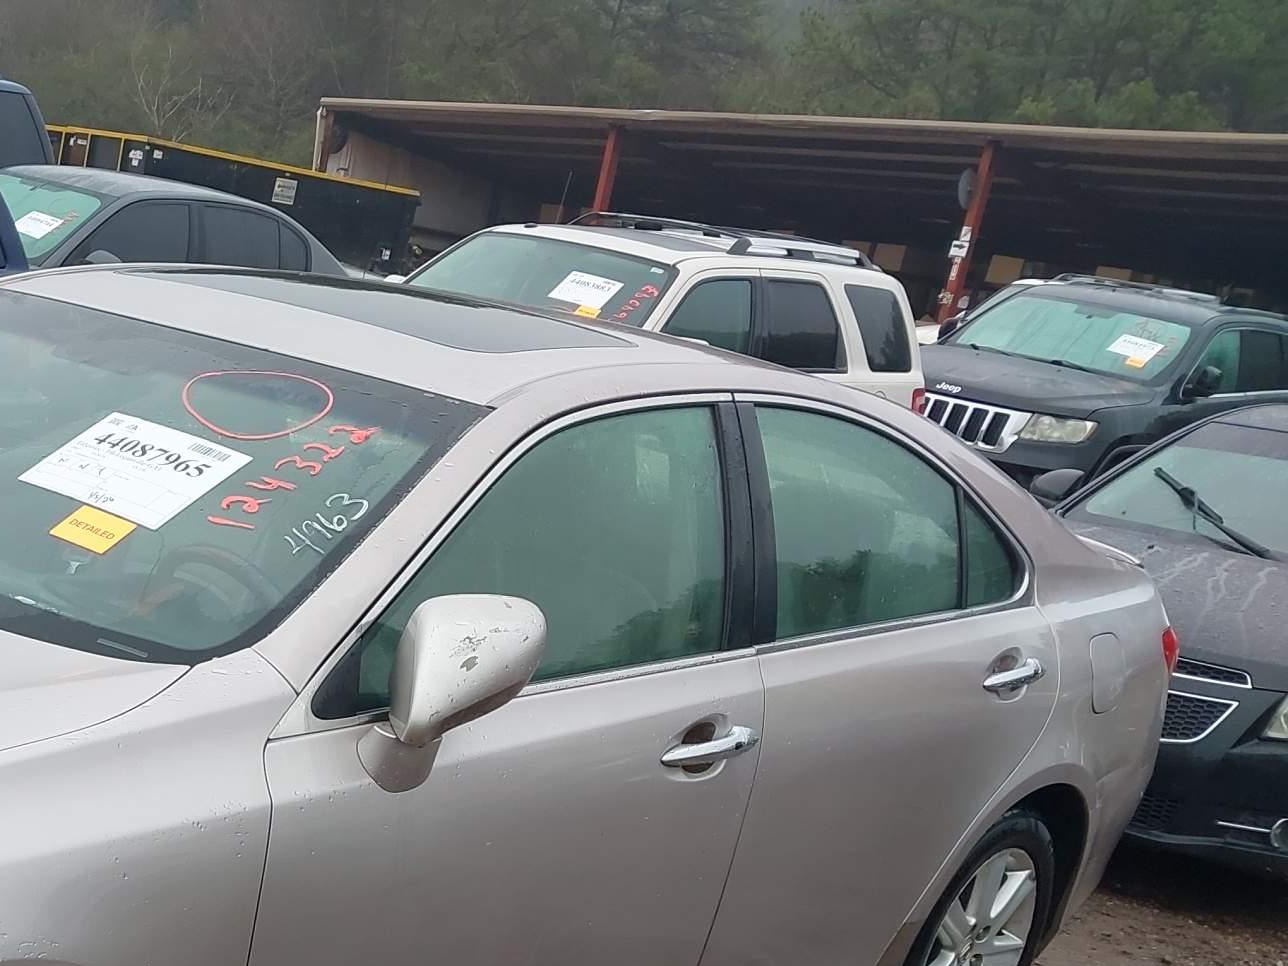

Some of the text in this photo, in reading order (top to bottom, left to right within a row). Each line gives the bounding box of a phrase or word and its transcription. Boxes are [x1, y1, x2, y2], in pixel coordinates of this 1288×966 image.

[935, 381, 962, 394] Jeep
[94, 432, 212, 478] 44087965
[68, 518, 116, 540] DETAILED
[284, 493, 370, 555] 4963
